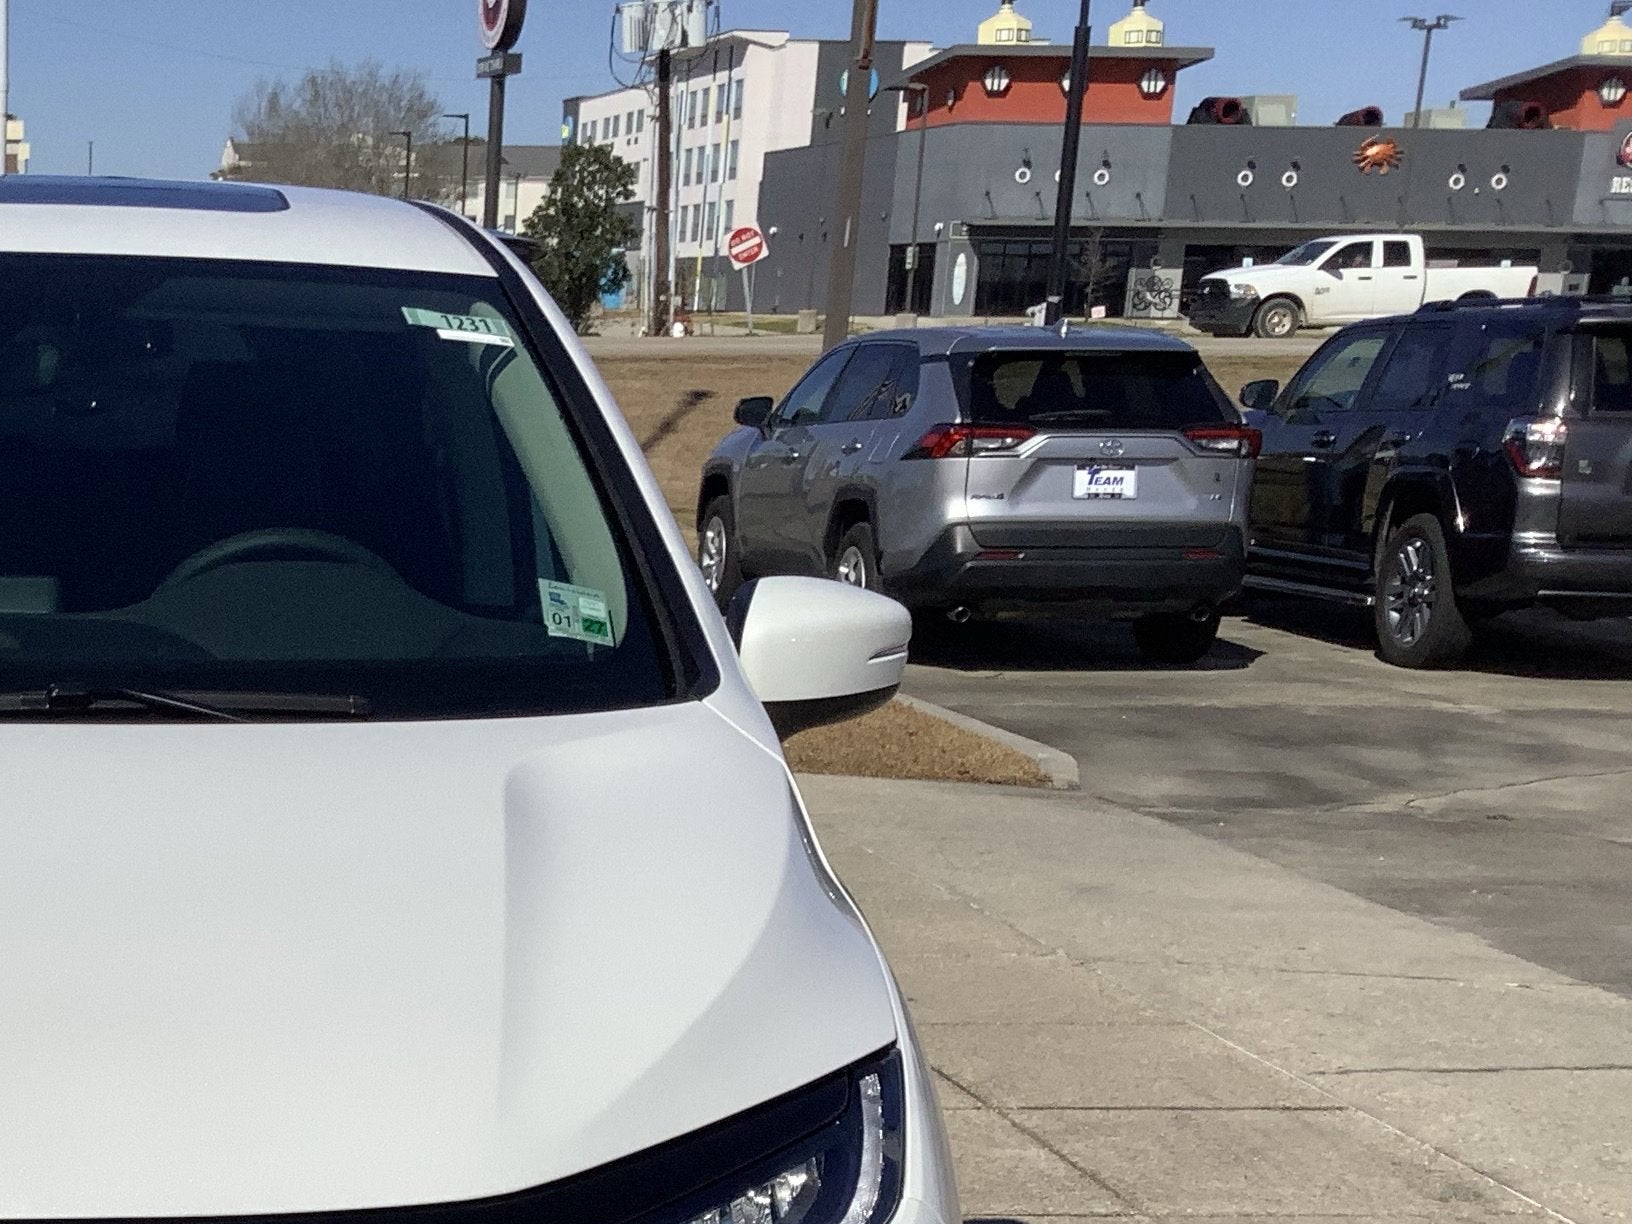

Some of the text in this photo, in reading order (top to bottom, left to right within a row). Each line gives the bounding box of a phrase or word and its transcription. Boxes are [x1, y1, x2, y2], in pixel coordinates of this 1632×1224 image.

[730, 229, 755, 247] DO NOT
[738, 245, 759, 261] ENTER
[440, 314, 492, 334] 1231
[552, 612, 605, 635] 01 27
